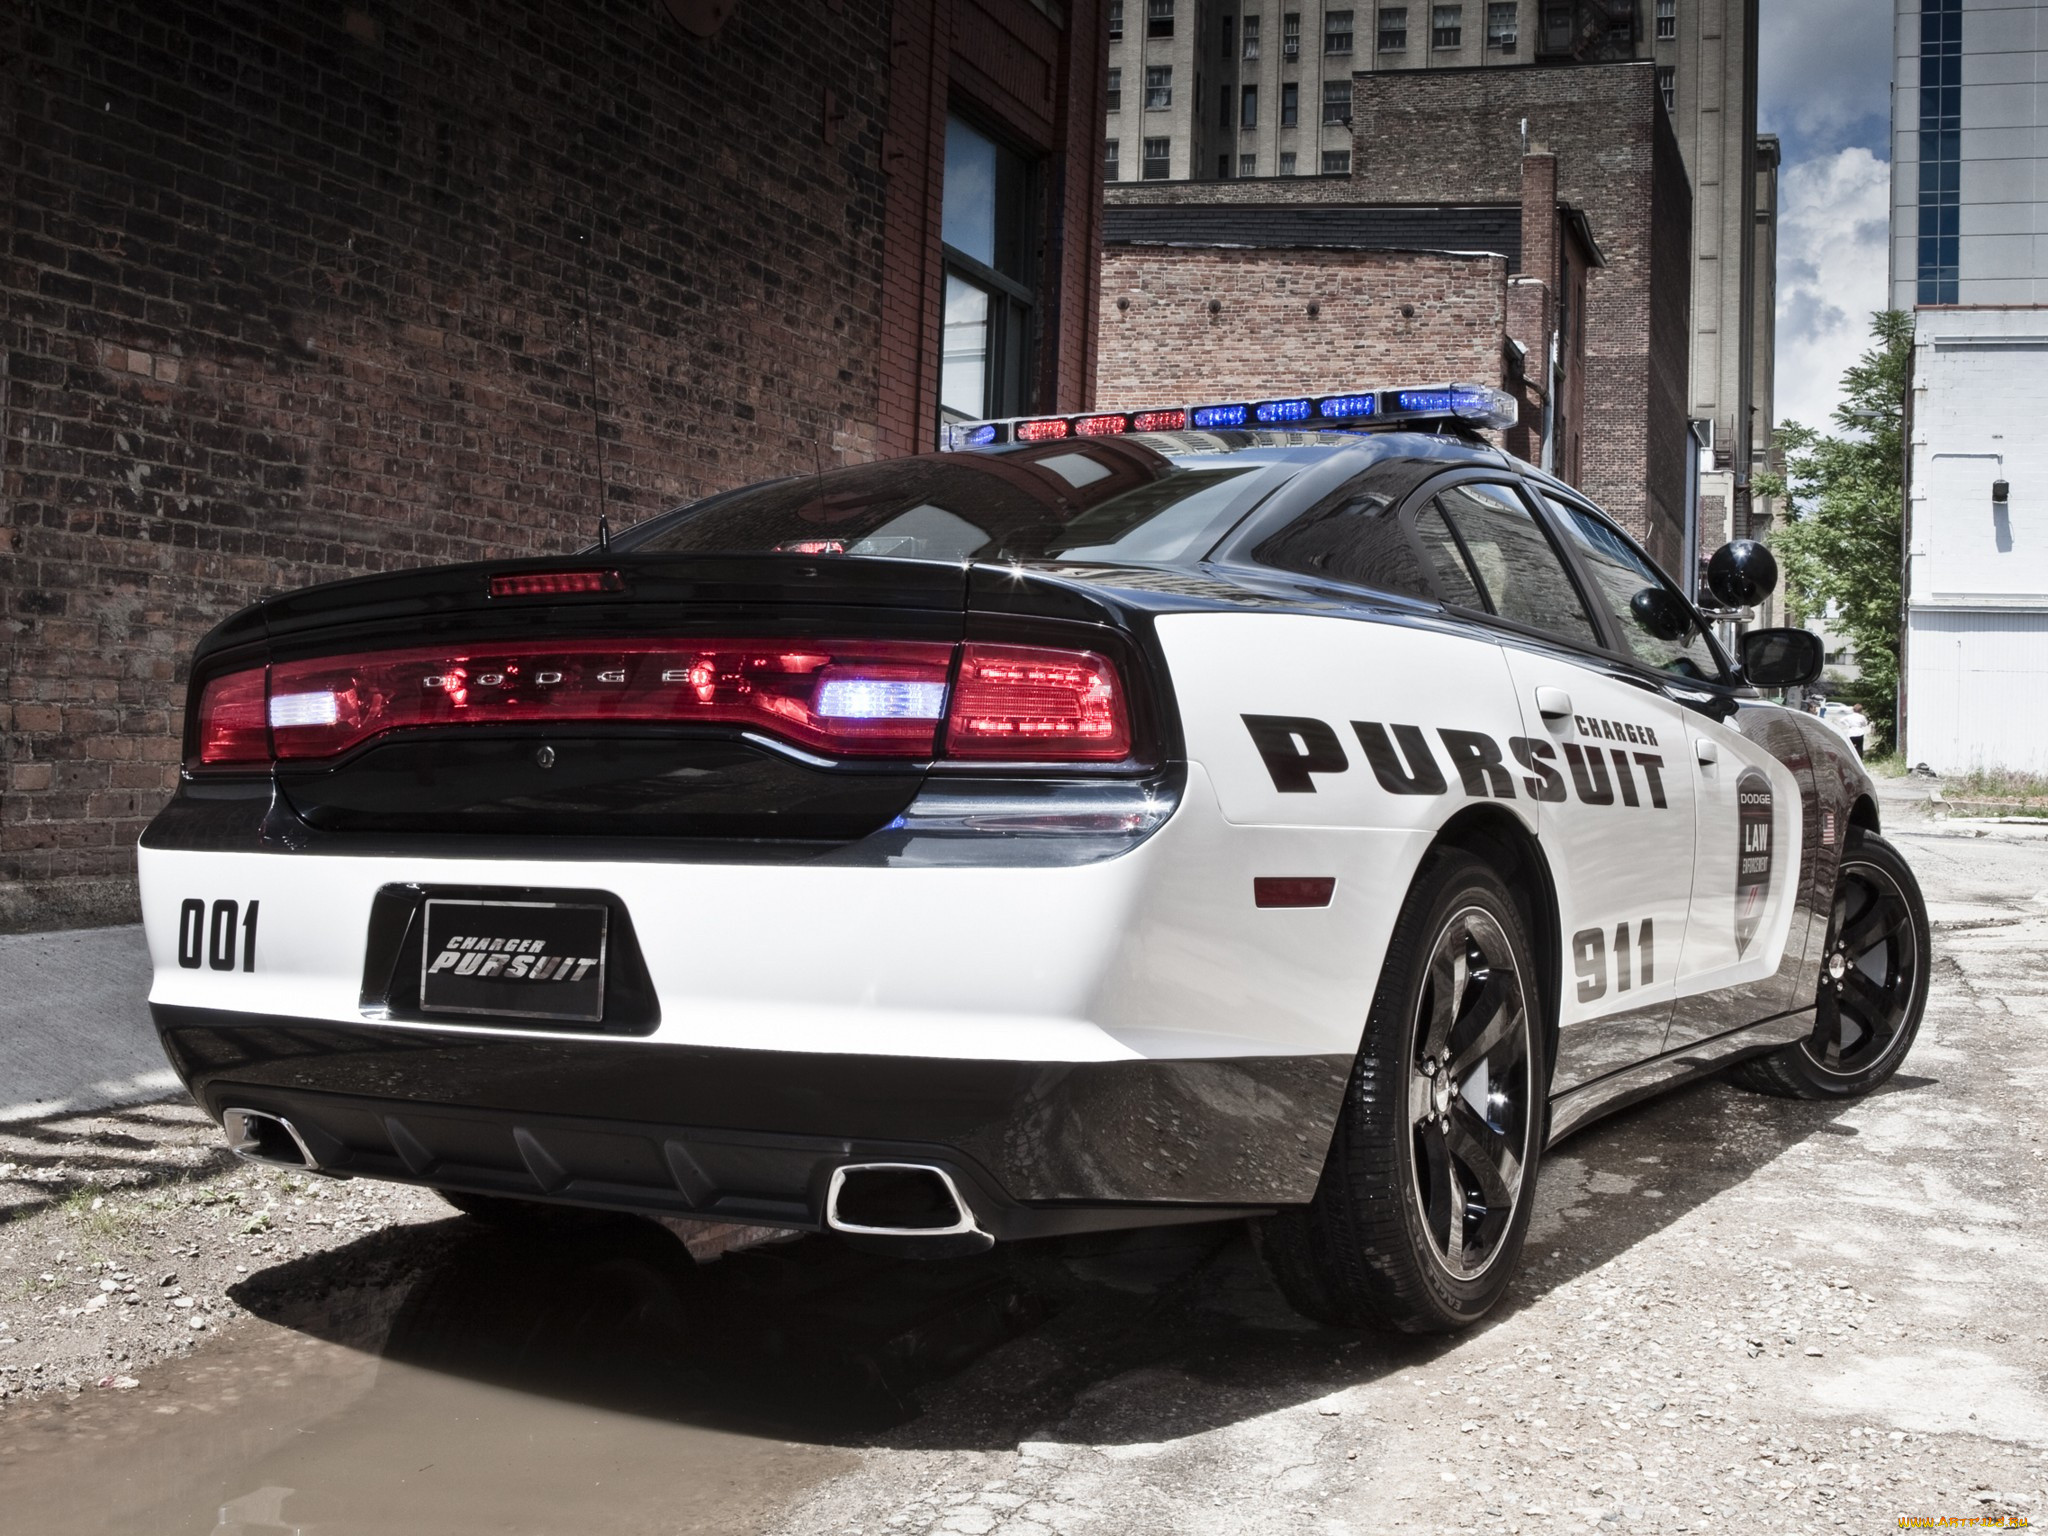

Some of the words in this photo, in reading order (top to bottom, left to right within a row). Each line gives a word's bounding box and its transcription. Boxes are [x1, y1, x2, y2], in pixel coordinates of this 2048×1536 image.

[423, 668, 691, 688] DODGE
[1574, 715, 1659, 747] CHARGER
[1239, 713, 1669, 809] PURSUIT
[1740, 793, 1772, 805] DODGE
[1745, 823, 1769, 853] LAW
[178, 898, 260, 973] 001
[446, 936, 547, 953] CHARGER
[428, 951, 599, 982] PURSUIT
[1572, 917, 1654, 1004] 911
